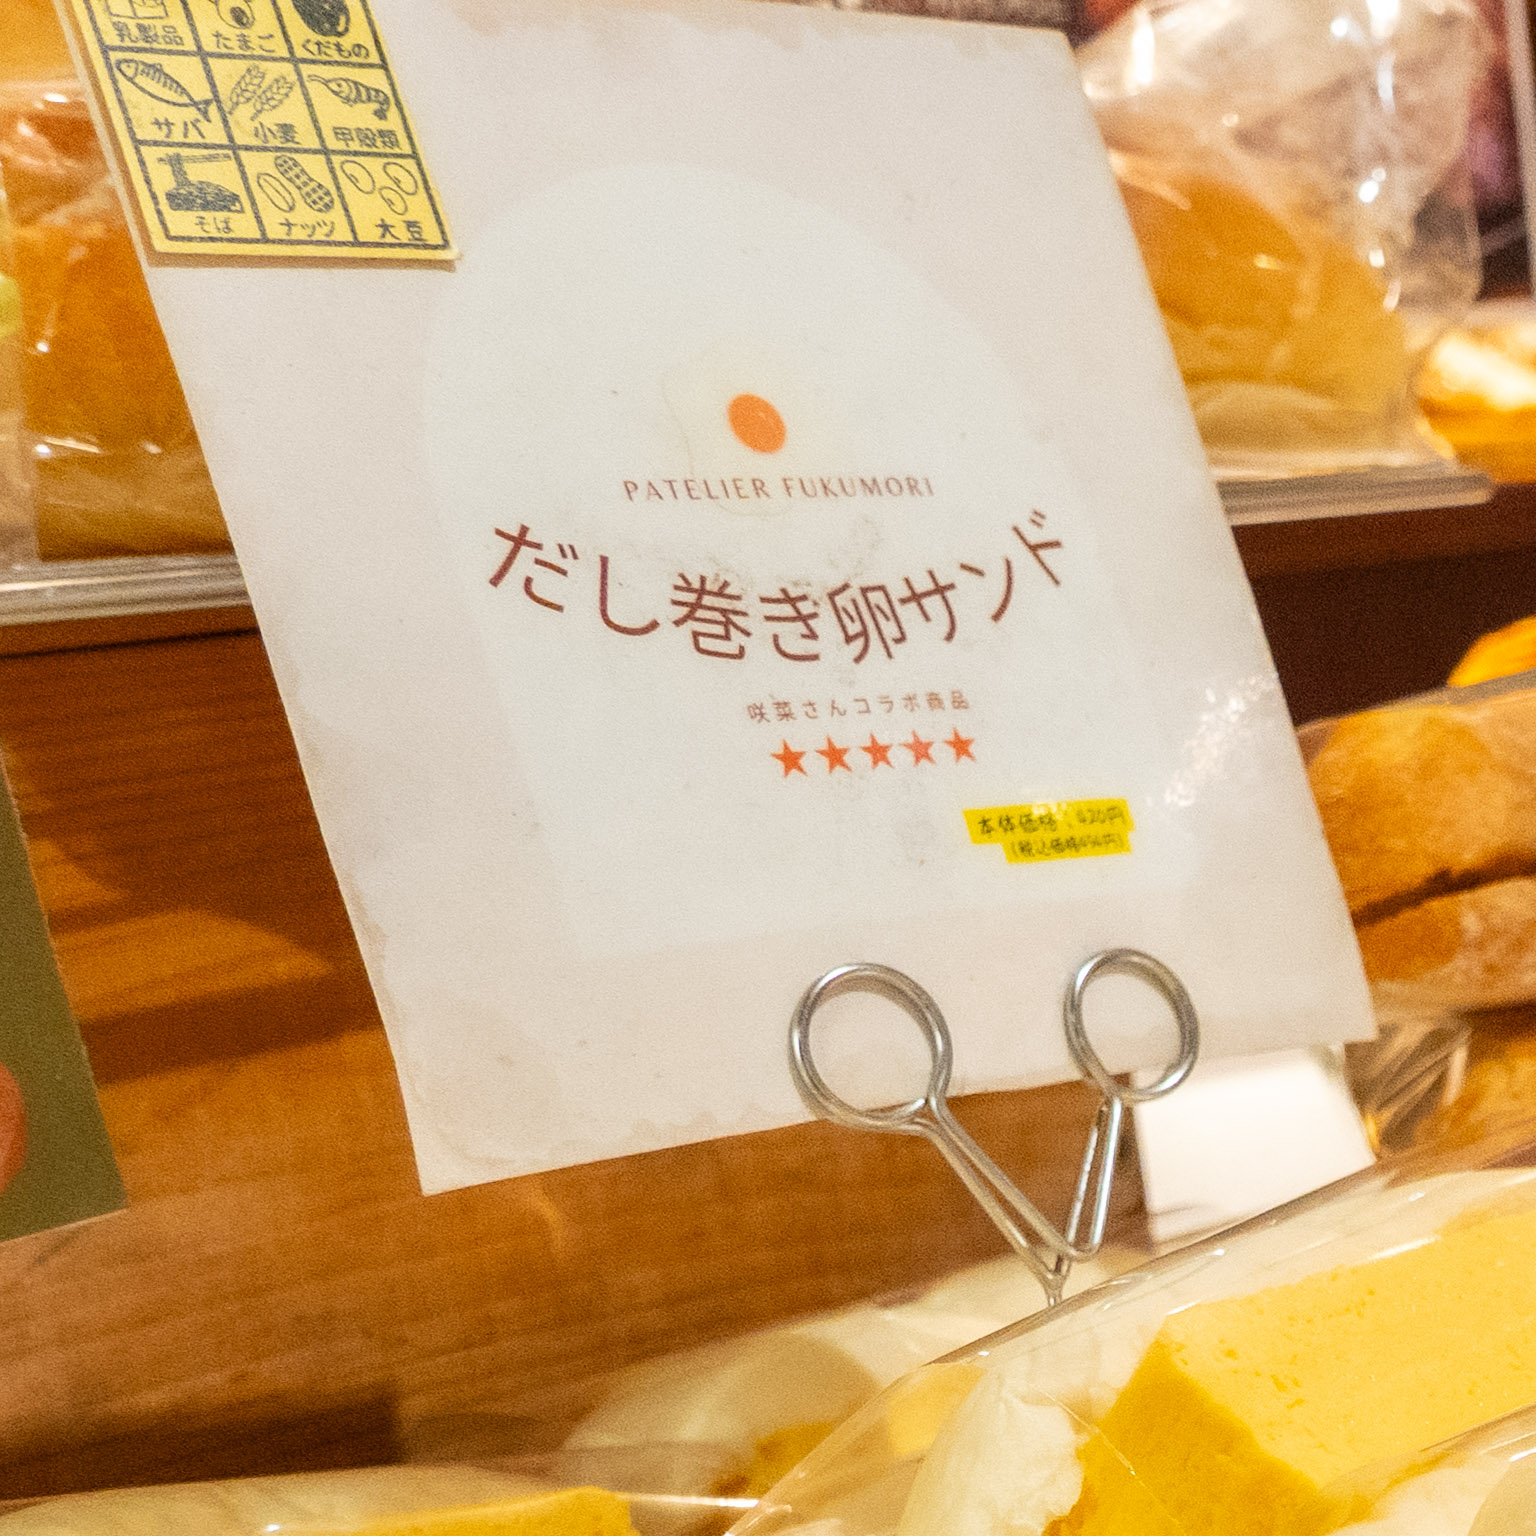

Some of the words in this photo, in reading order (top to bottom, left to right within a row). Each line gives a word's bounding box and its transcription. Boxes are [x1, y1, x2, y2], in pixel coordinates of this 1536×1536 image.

[111, 20, 185, 46] 乳製品
[211, 30, 277, 54] たまご
[302, 40, 370, 60] くだもの
[151, 117, 206, 141] サバ
[253, 120, 301, 146] 小麦
[333, 126, 402, 151] 甲殻類
[193, 214, 233, 236] そば
[278, 218, 336, 239] ナッツ
[374, 218, 428, 243] 大豆
[622, 476, 771, 503] PATELIER
[781, 474, 936, 500] FUKUMORI
[487, 508, 1063, 665] だし巻き卵サンド
[746, 688, 970, 724] 咲菜さんコラボ商品
